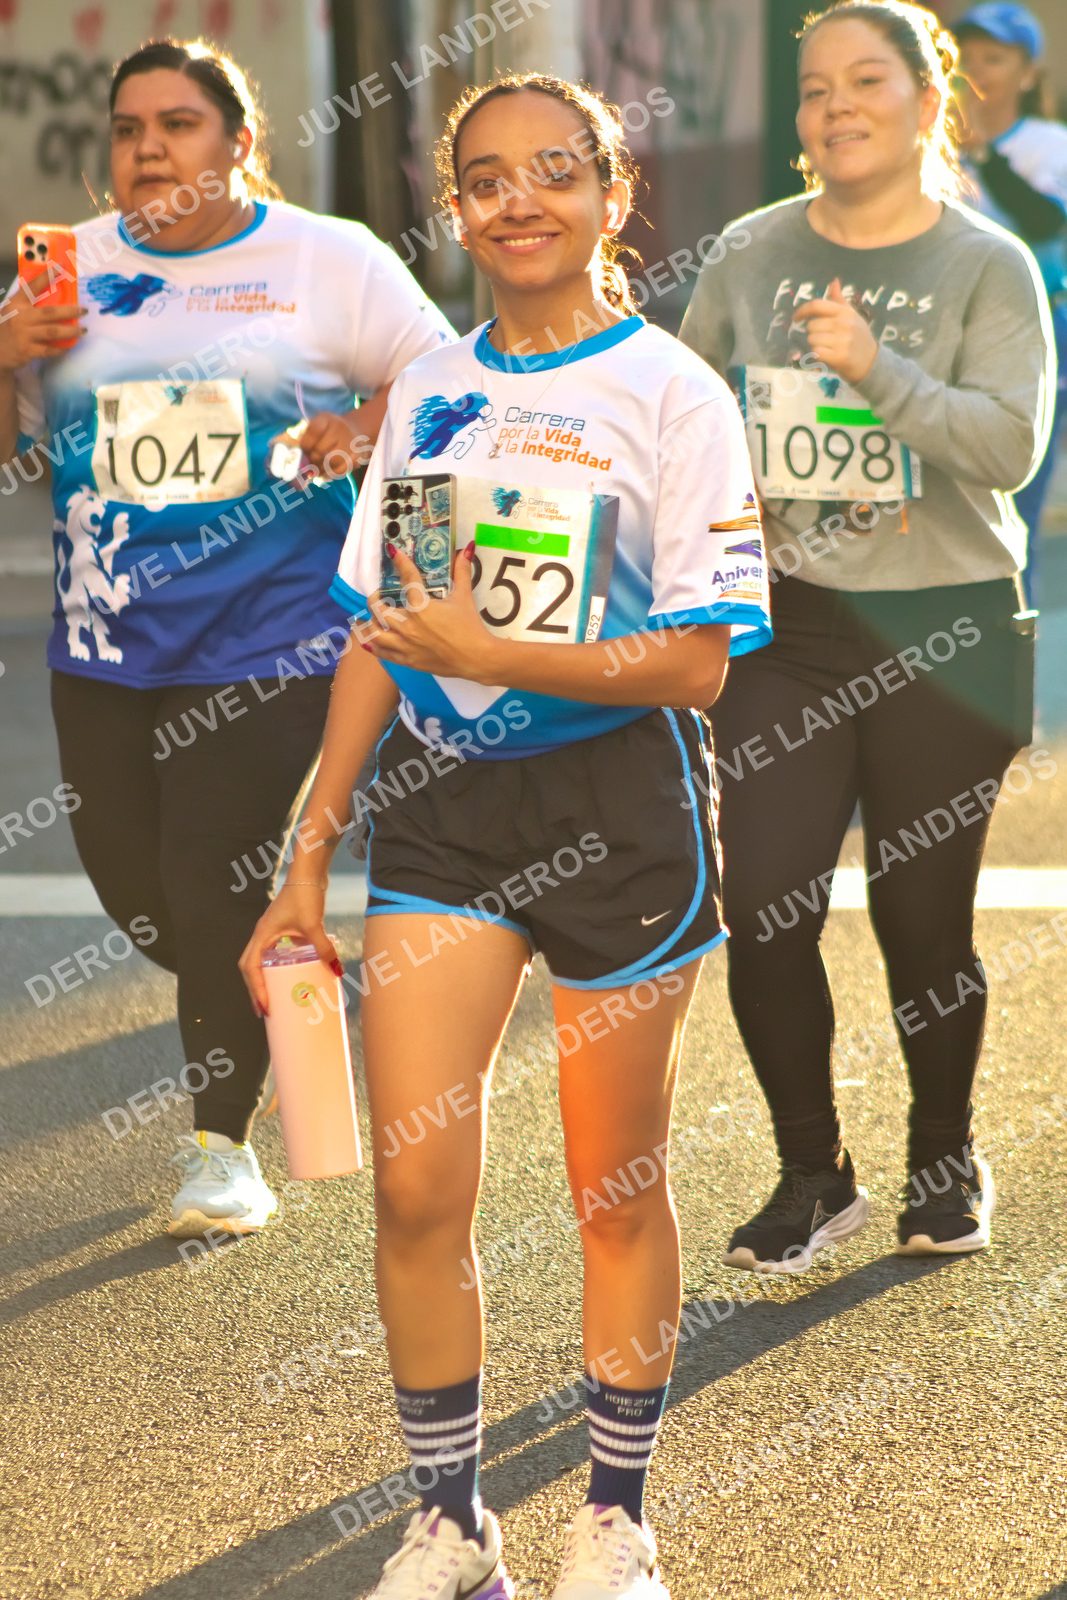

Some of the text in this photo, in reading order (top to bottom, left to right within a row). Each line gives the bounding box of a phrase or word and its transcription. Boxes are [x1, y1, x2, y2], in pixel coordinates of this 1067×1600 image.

[190, 281, 267, 297] Carrera
[233, 293, 267, 303] Vida
[215, 301, 296, 314] Integridad
[504, 406, 586, 431] Carrera
[497, 426, 582, 447] por la Vida
[106, 432, 241, 487] 1047
[505, 438, 518, 454] la
[522, 442, 612, 470] Integridad
[755, 423, 895, 484] 1098
[586, 614, 601, 642] 1952
